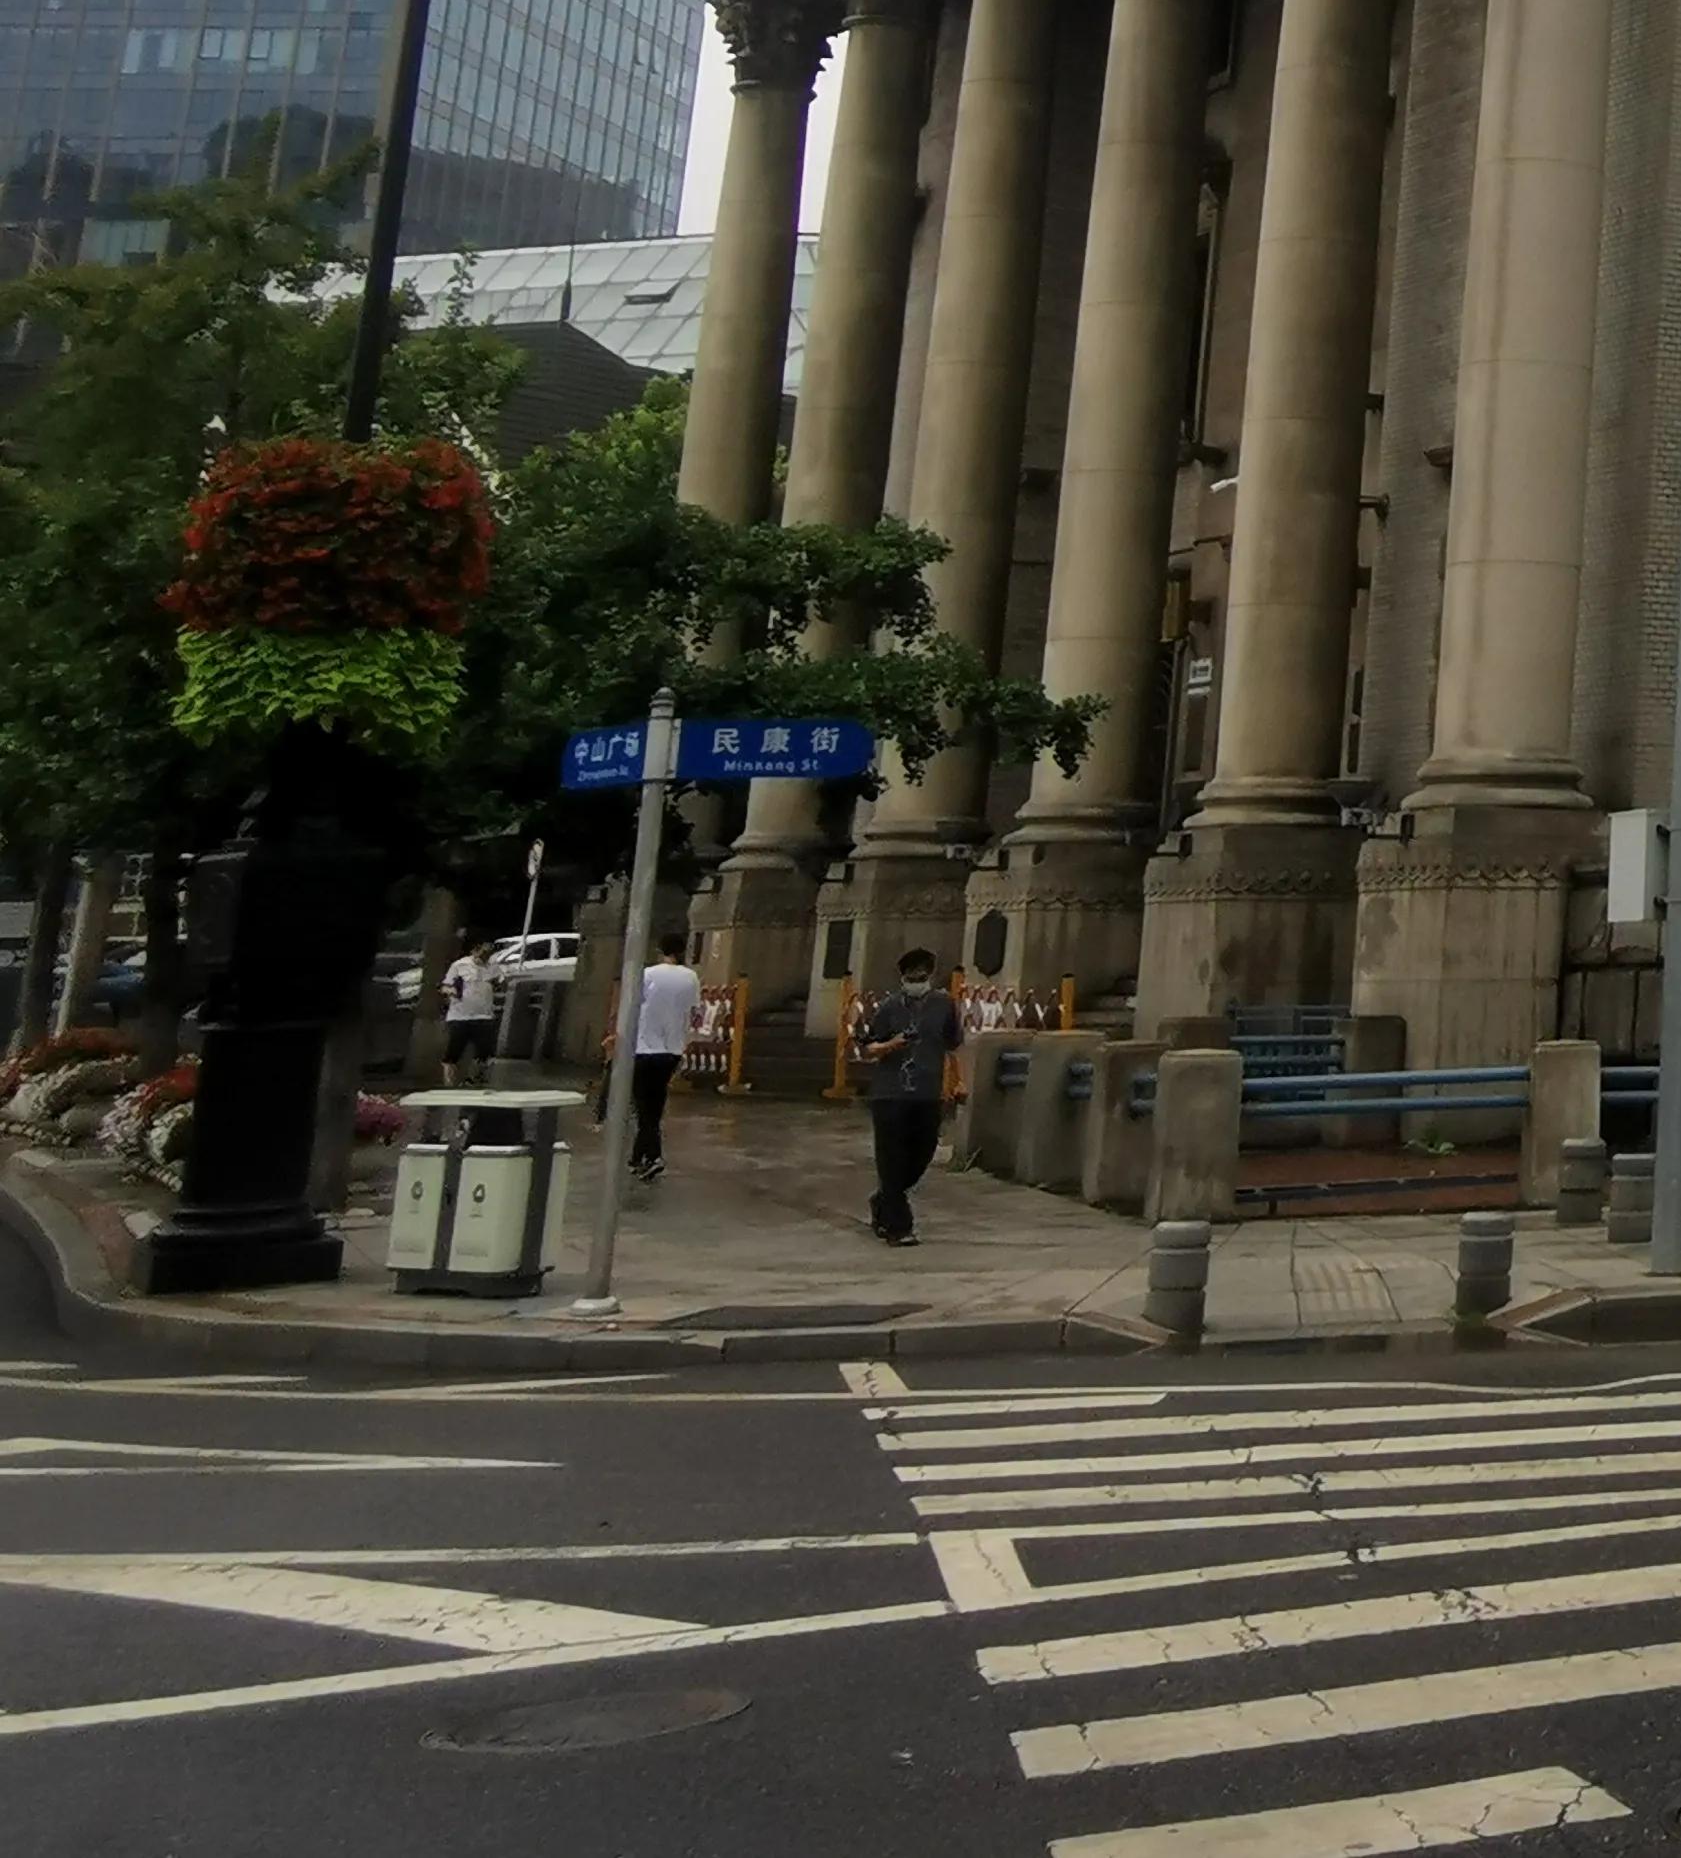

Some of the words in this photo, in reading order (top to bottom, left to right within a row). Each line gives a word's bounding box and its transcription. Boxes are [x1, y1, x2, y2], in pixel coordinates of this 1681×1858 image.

[574, 731, 640, 766] 中山广场
[711, 726, 840, 754] 民康街
[723, 760, 796, 773] Minkang
[800, 758, 819, 772] St
